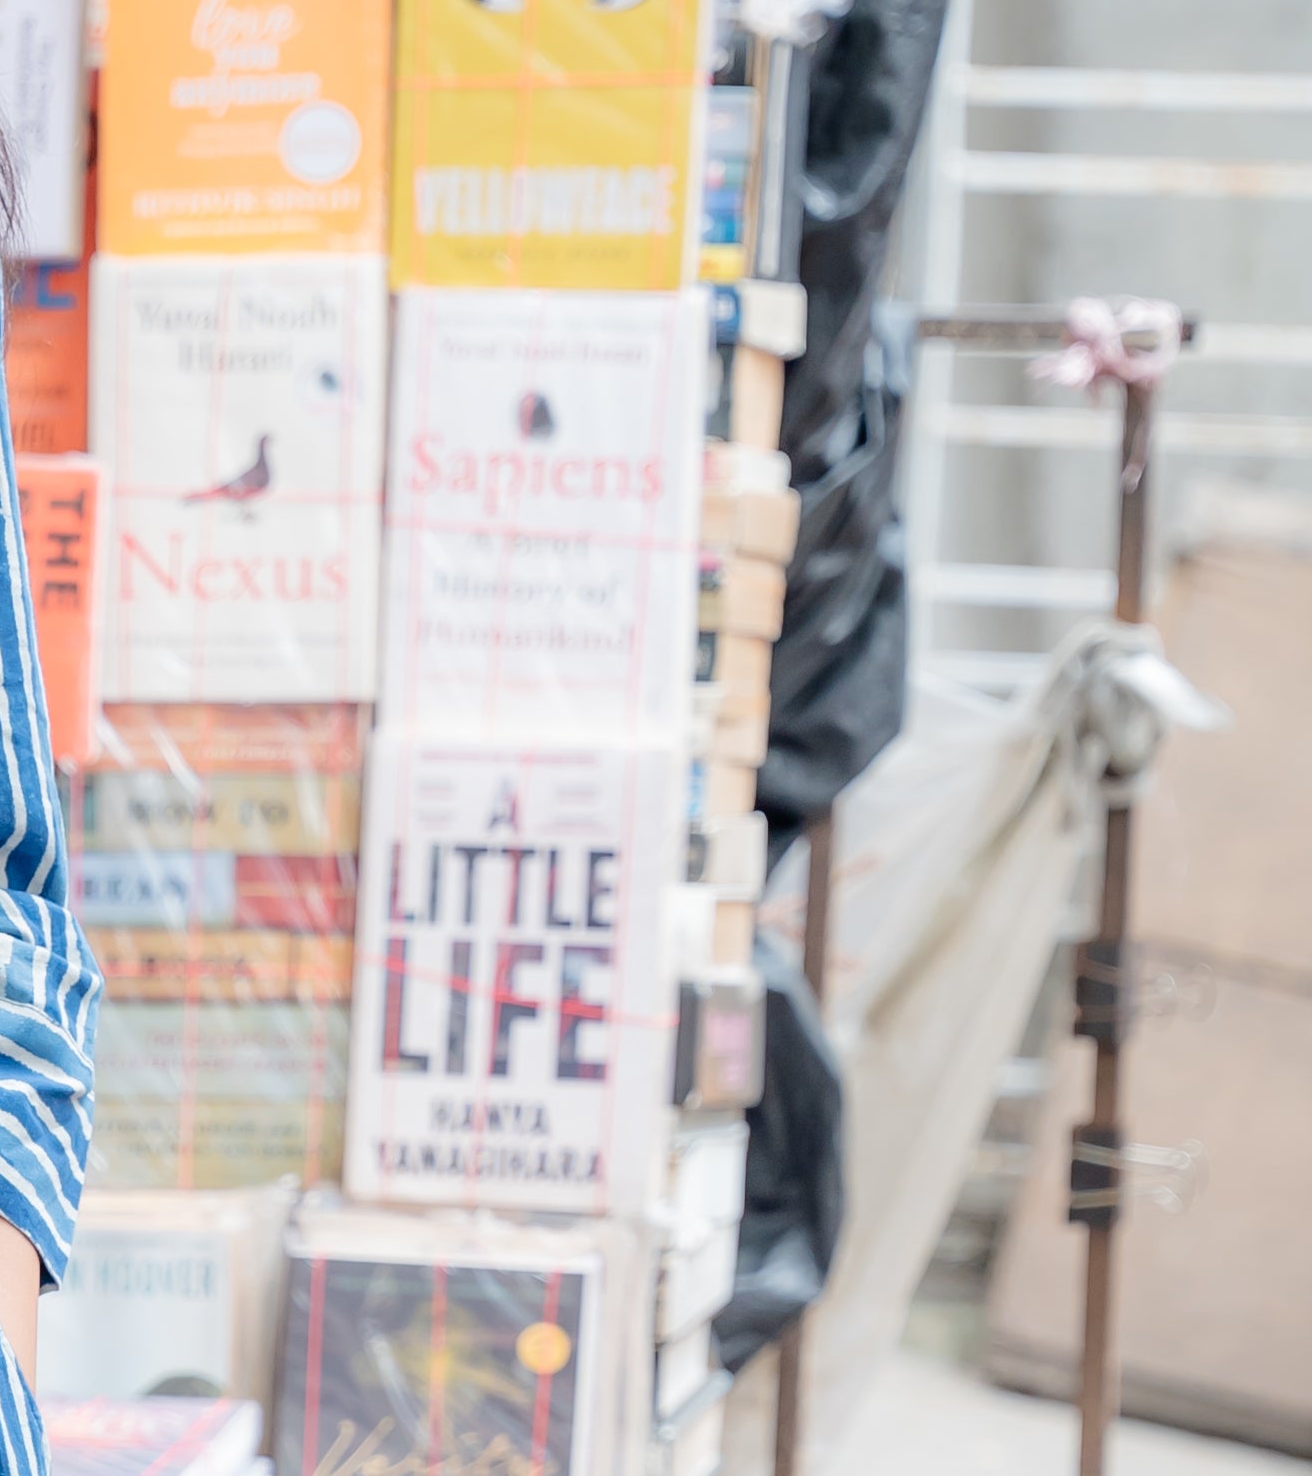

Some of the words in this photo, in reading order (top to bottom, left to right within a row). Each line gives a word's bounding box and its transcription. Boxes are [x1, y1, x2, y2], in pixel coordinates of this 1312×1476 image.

[415, 164, 678, 237] YELLOWFACE
[406, 435, 667, 514] Sapiens
[41, 488, 85, 612] THE
[116, 530, 351, 607] Nexus
[488, 776, 522, 833] A
[389, 844, 621, 928] LITTLE
[379, 942, 613, 1082] LIFE
[430, 1099, 554, 1138] HANYA
[372, 1142, 608, 1185] YANAGIHARA
